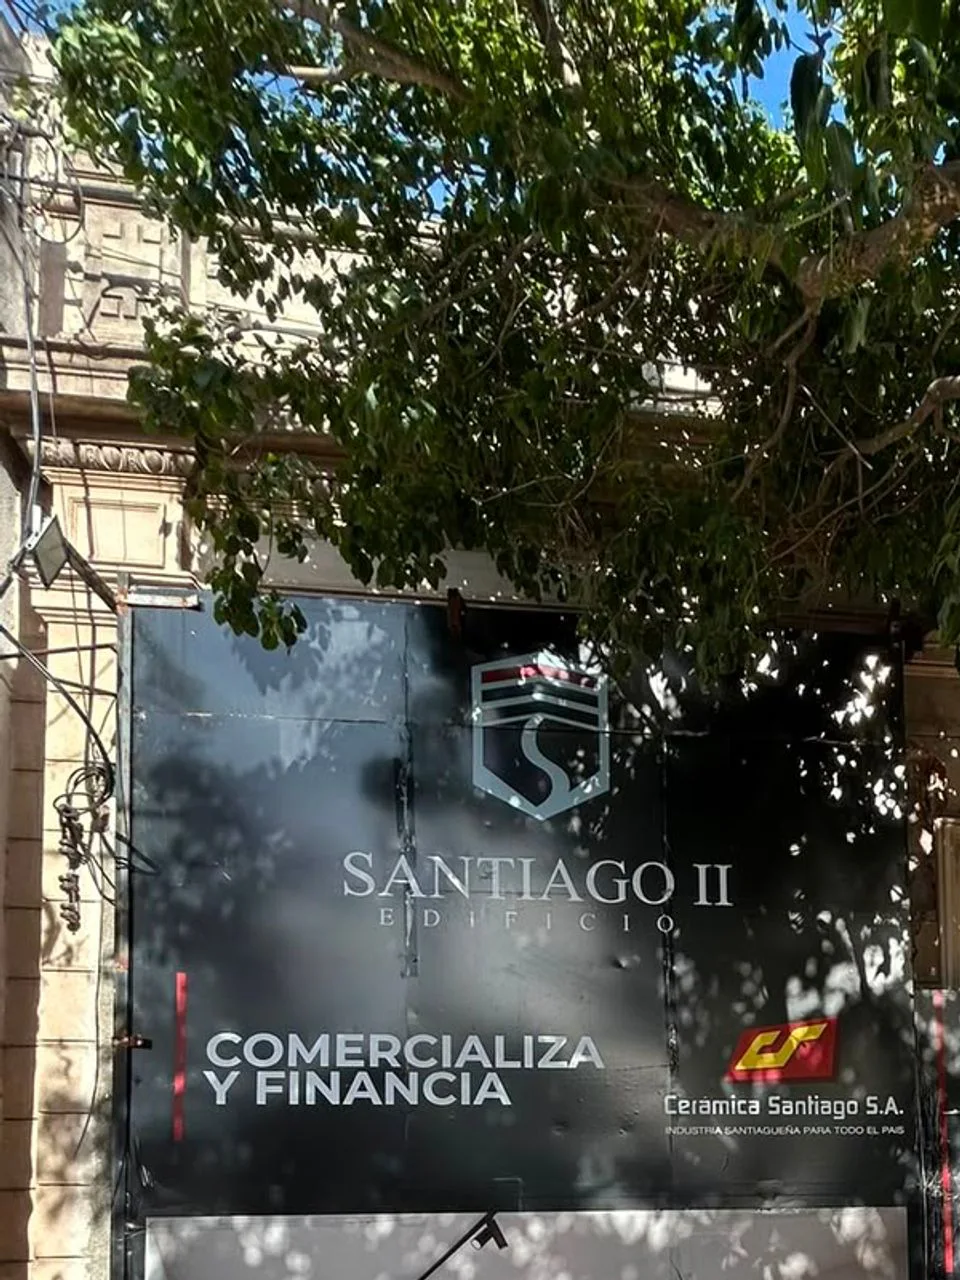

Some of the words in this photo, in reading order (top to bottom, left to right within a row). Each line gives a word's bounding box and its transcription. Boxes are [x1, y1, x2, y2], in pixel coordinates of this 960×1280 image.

[342, 851, 675, 905] SANTIAGO
[692, 863, 734, 906] II
[379, 907, 676, 933] EDIFICIO
[205, 1032, 605, 1069] COMERCIALIZA
[202, 1071, 241, 1105] Y
[256, 1071, 512, 1106] FINANCIA
[767, 1095, 858, 1120] Santiago
[865, 1095, 904, 1116] S.A.
[665, 1125, 723, 1135] INDUSTRIA
[724, 1125, 801, 1136] SANTIAGUEÑA
[803, 1126, 831, 1135] PARA
[834, 1126, 864, 1135] TODO
[866, 1126, 879, 1135] EL
